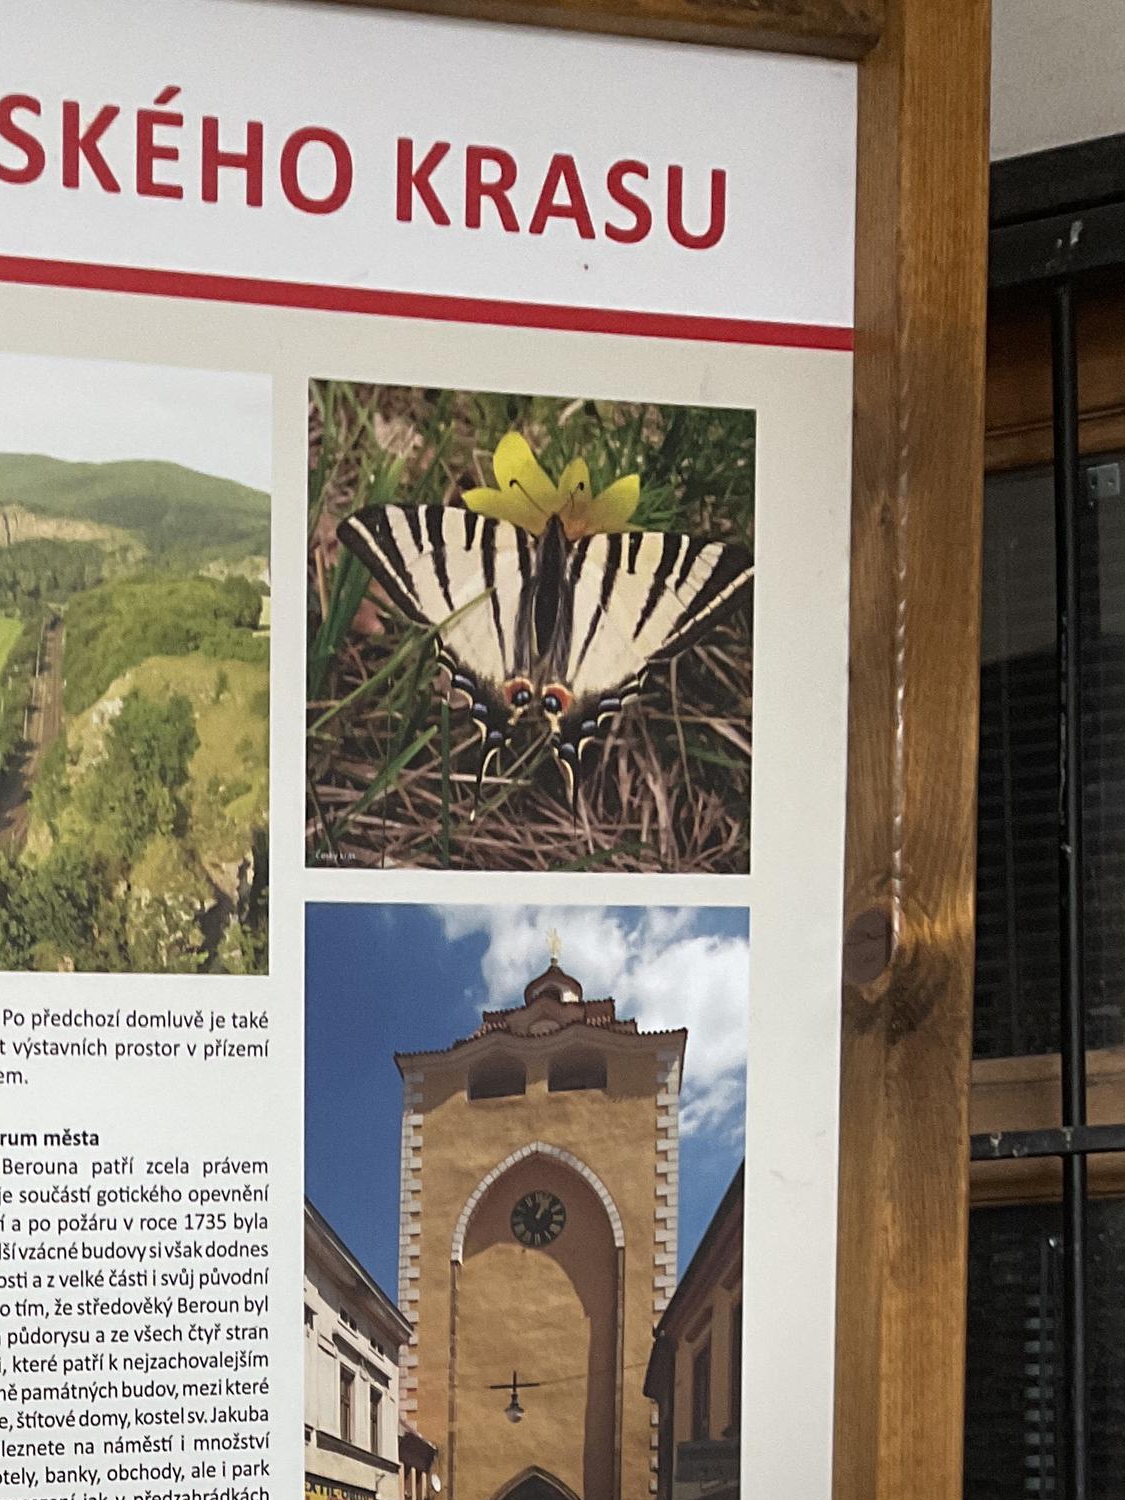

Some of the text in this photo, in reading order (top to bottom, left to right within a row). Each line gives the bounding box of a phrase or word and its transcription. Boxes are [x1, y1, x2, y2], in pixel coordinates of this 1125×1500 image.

[395, 137, 728, 251] KRASU
[3, 1008, 25, 1027] Po
[31, 1007, 121, 1031] předchozí
[126, 1009, 204, 1029] domluvě
[209, 1010, 226, 1033] je
[231, 1010, 269, 1029] také
[12, 1036, 107, 1060] výstavních
[115, 1040, 181, 1061] prostor
[186, 1043, 197, 1057] v
[203, 1038, 270, 1061] přízemí
[43, 1128, 100, 1147] města
[2, 1157, 78, 1176] Berouna
[92, 1155, 134, 1180] patří
[146, 1156, 189, 1175] zcela
[203, 1155, 268, 1179] právem
[11, 1218, 21, 1232] a
[28, 1218, 51, 1237] po
[57, 1212, 117, 1236] požáru
[123, 1217, 134, 1231] v
[140, 1217, 178, 1231] roce
[184, 1212, 227, 1231] 1735
[233, 1212, 268, 1234] byla
